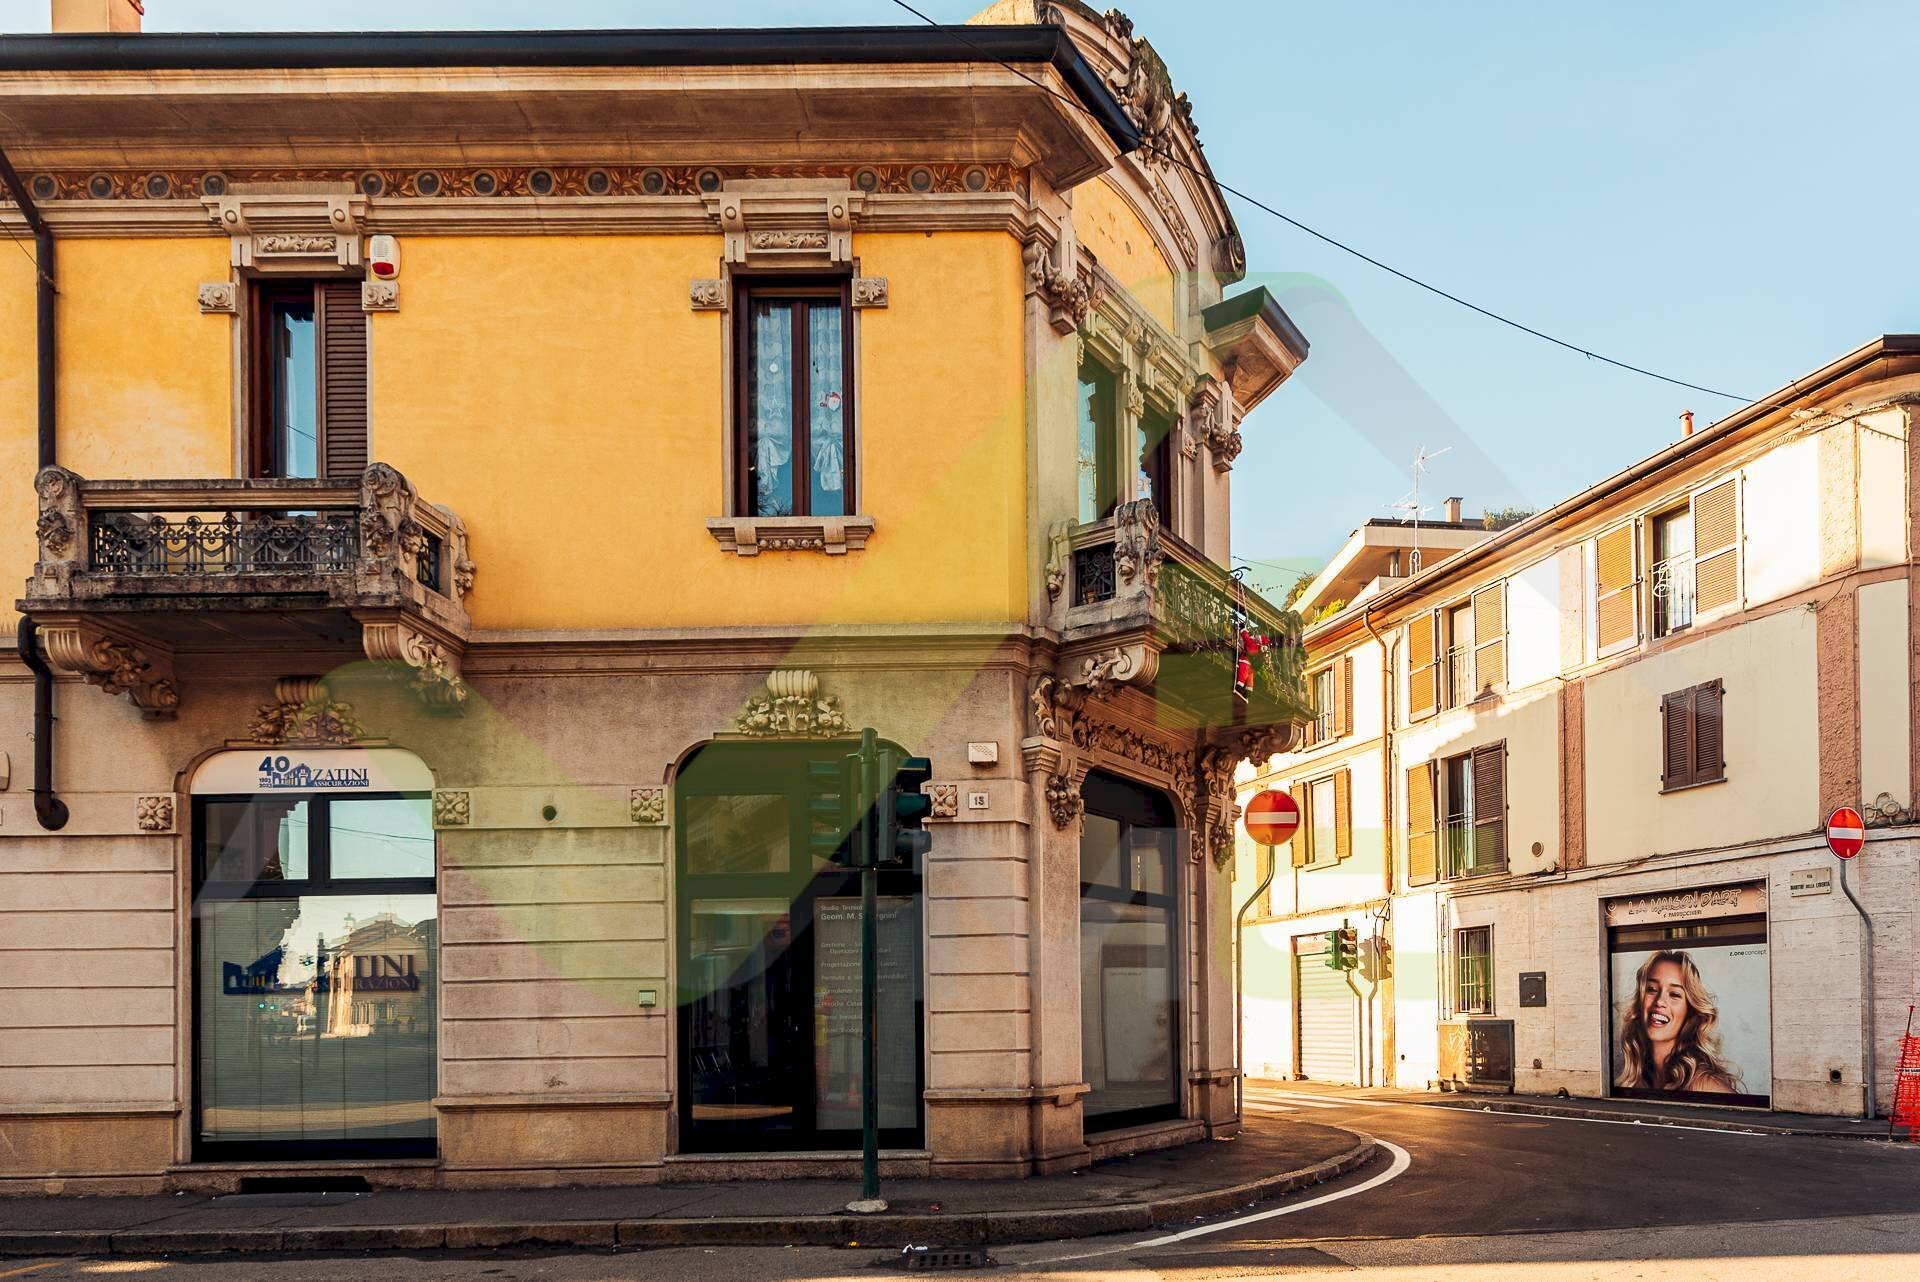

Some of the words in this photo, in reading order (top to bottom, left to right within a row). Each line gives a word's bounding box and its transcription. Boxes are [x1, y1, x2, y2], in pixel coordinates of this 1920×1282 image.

[259, 756, 290, 776] 40
[313, 768, 368, 781] ZATINI
[1628, 899, 1648, 915] LA
[1650, 890, 1699, 915] MAISON
[1700, 889, 1742, 908] D'ART
[821, 913, 843, 921] Geom.
[1745, 948, 1767, 956] concept
